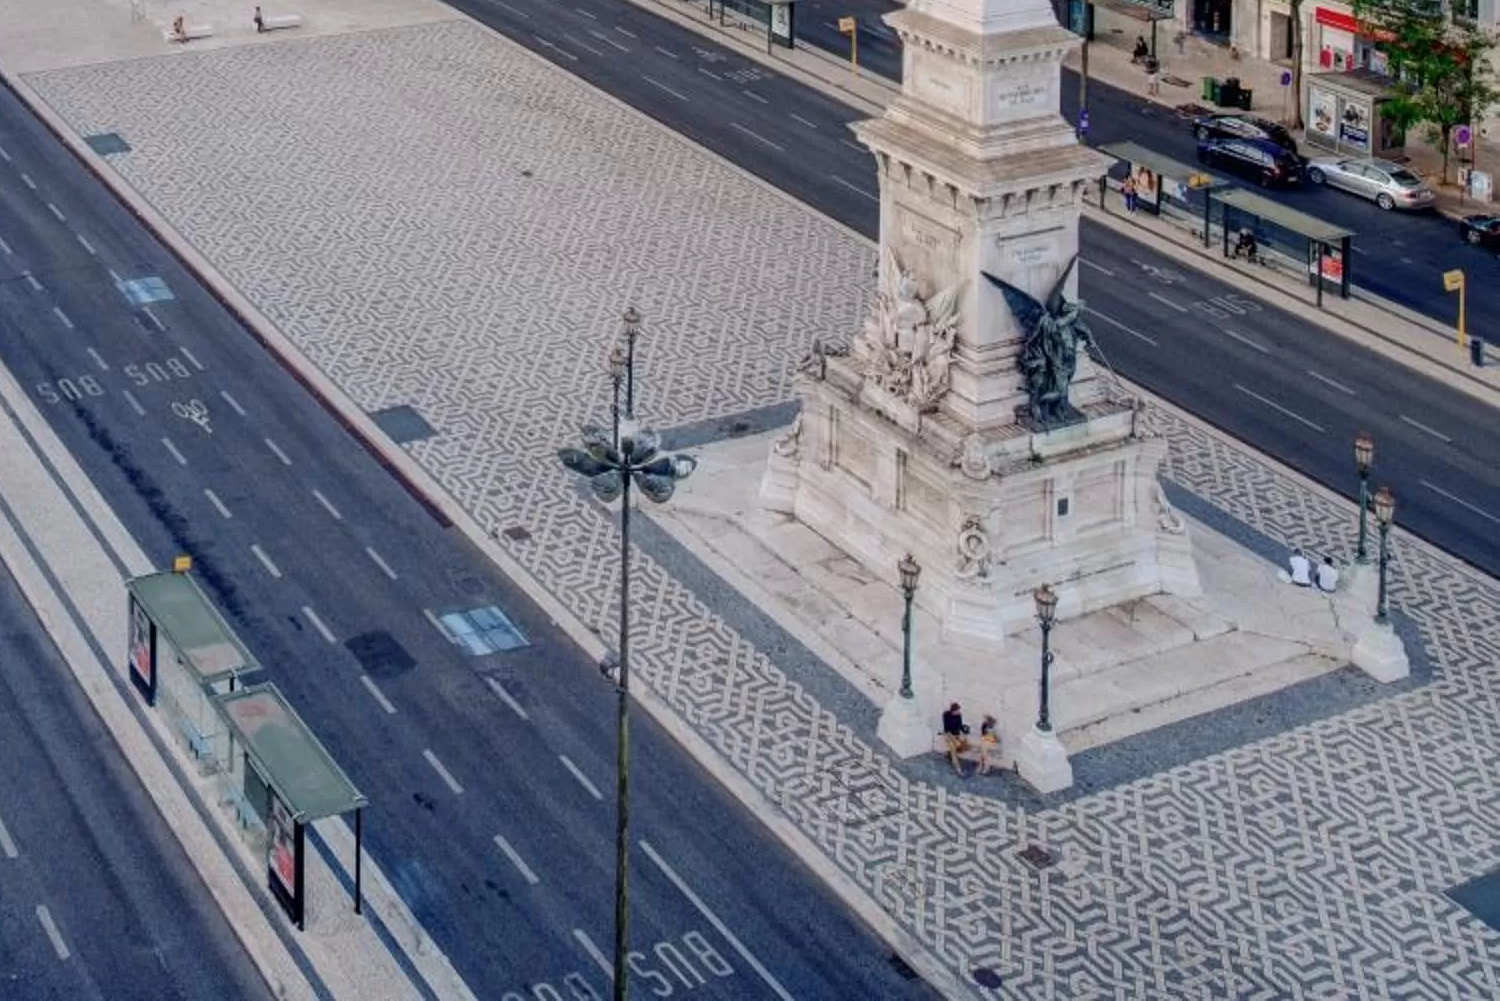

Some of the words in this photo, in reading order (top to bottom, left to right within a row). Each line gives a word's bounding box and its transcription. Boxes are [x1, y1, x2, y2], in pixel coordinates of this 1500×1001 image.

[124, 358, 191, 386] BUS
[36, 374, 104, 404] BUS
[627, 931, 734, 997] BUS
